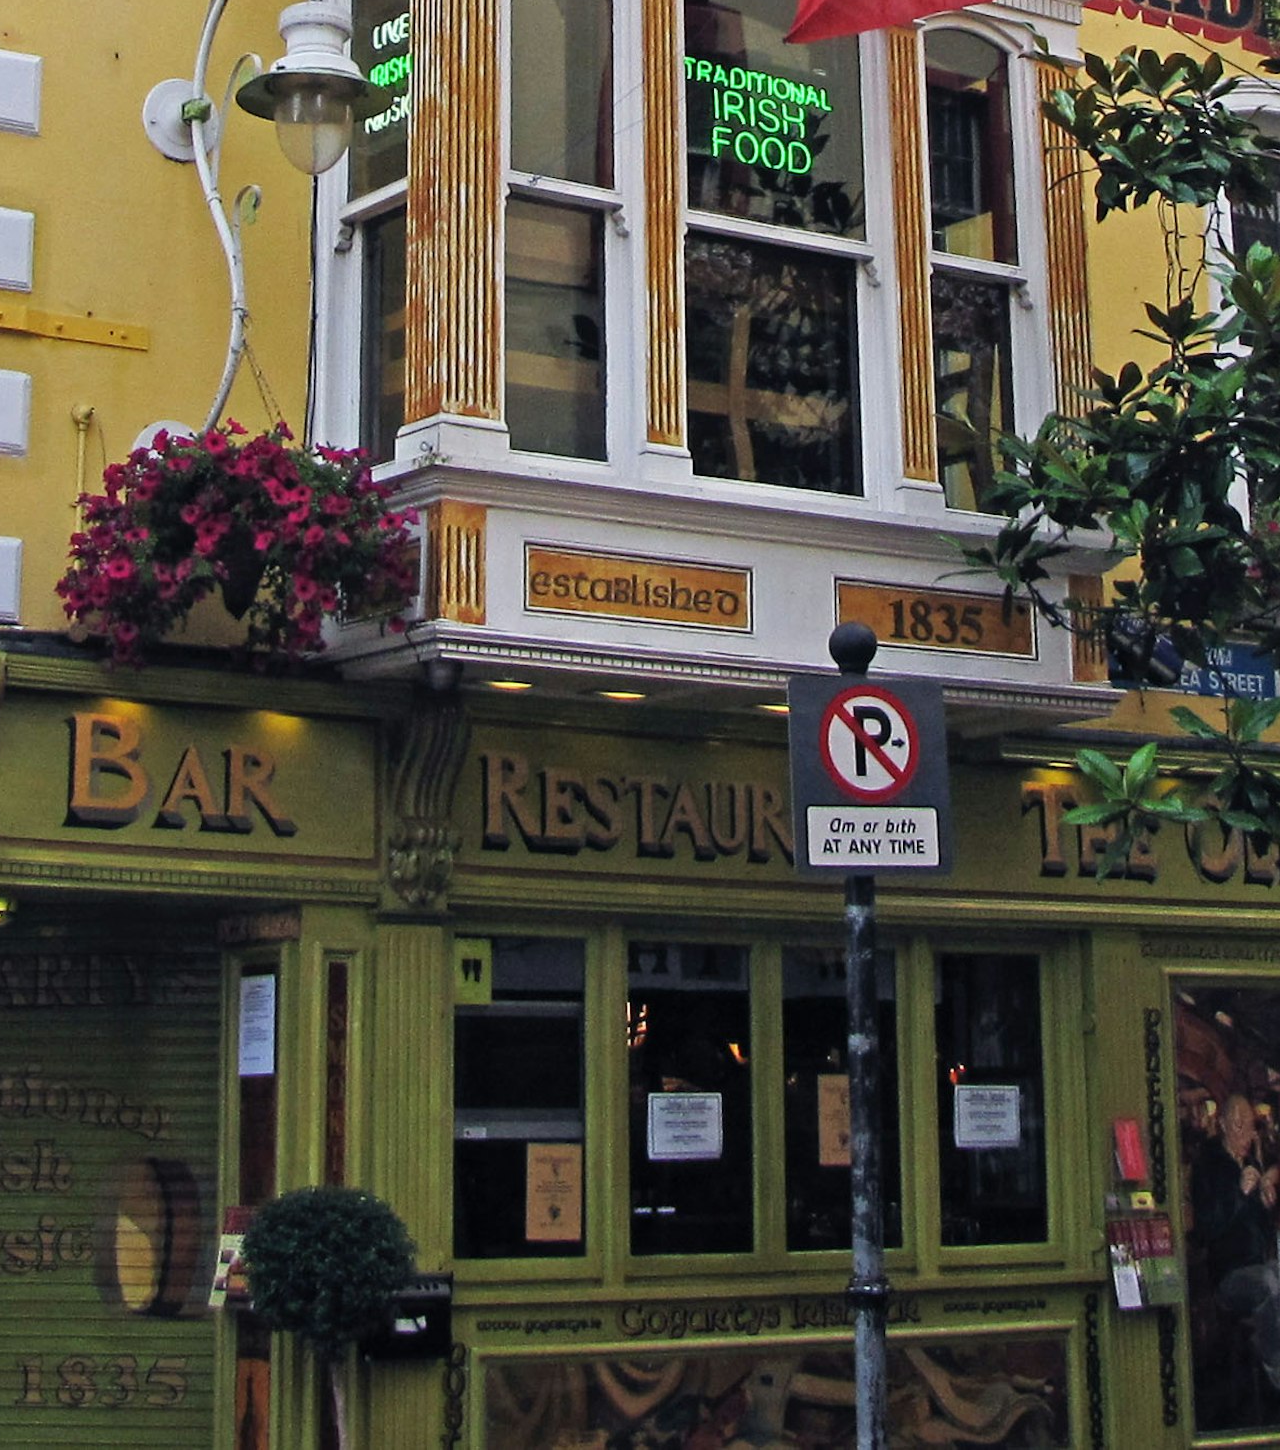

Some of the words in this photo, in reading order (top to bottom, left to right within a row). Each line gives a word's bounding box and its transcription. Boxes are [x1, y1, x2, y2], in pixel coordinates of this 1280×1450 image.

[684, 55, 833, 114] TRADITIONAL
[712, 90, 807, 139] IRISH
[710, 127, 813, 176] FOOD
[888, 598, 986, 648] 1835
[63, 709, 299, 839] BAR
[481, 754, 793, 866] RESTAUR
[823, 839, 841, 854] AT
[849, 839, 882, 854] ANY
[889, 839, 925, 854] TIME
[14, 1353, 191, 1409] 1835
